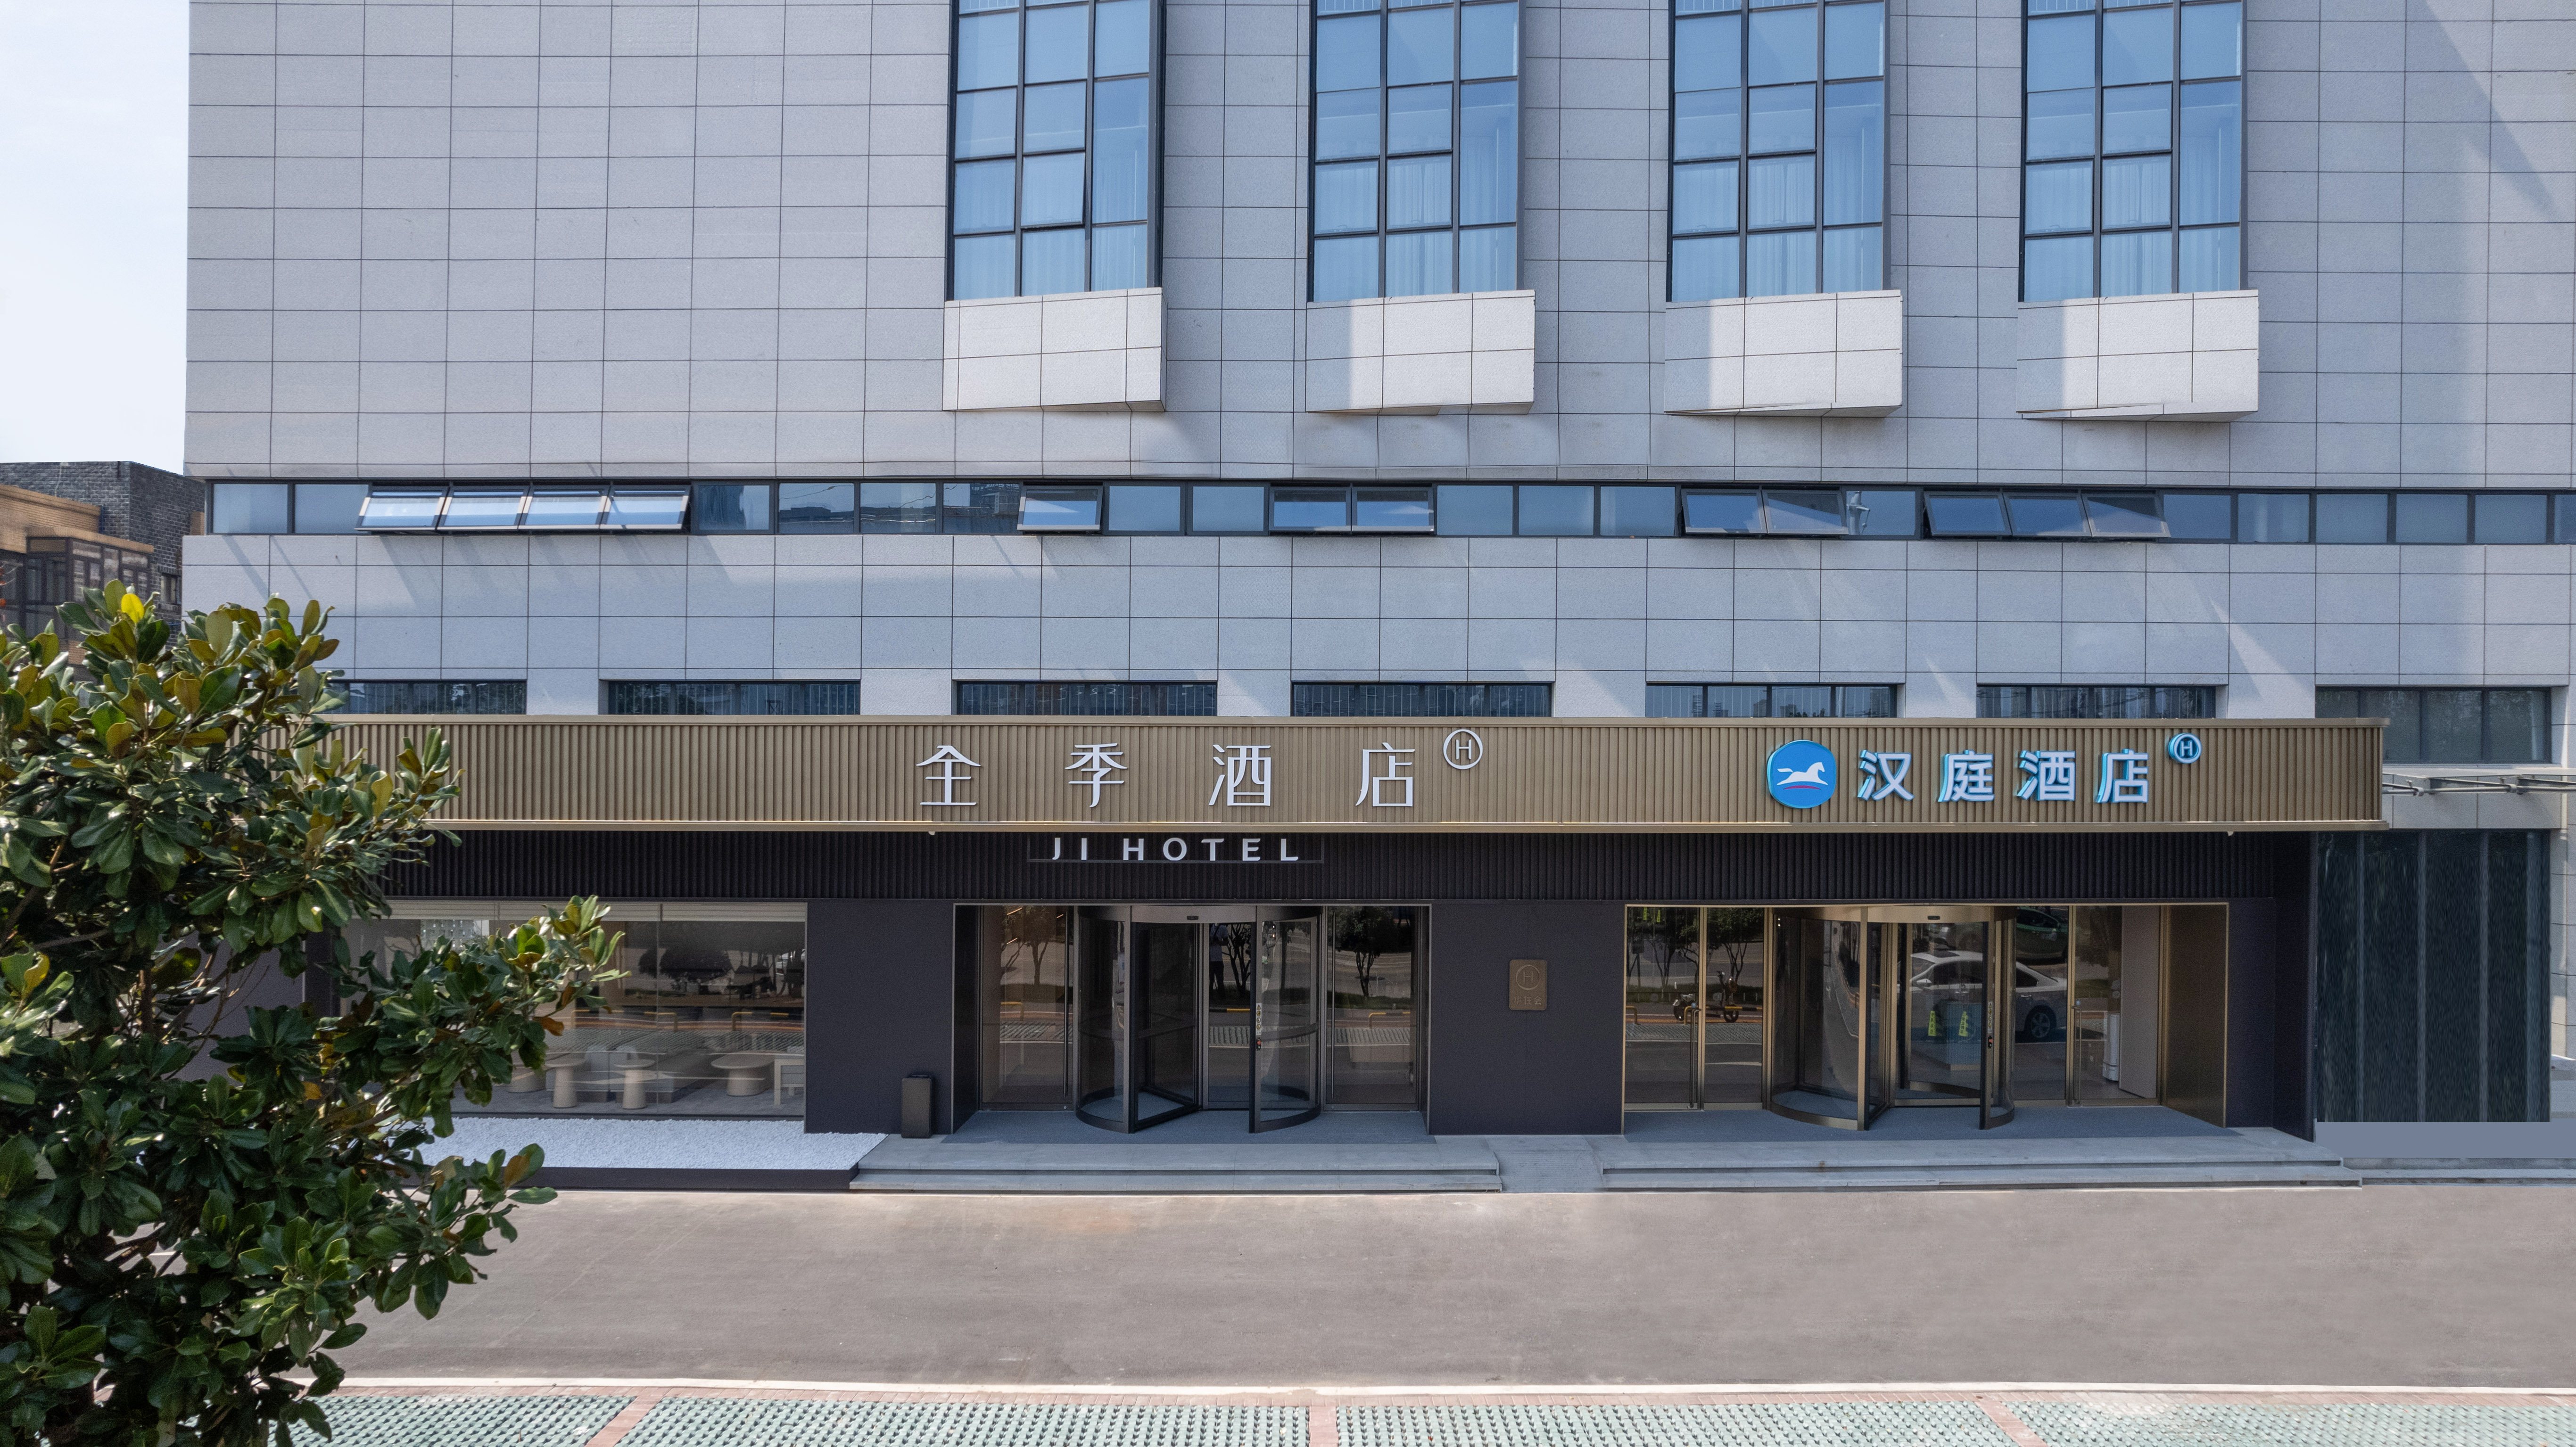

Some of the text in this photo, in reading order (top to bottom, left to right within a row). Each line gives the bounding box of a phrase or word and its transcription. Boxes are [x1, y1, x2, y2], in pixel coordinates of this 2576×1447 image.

[916, 743, 1415, 807] 全季酒店
[1858, 749, 2148, 803] 汉庭酒店
[1052, 837, 1299, 861] JI HOTEL
